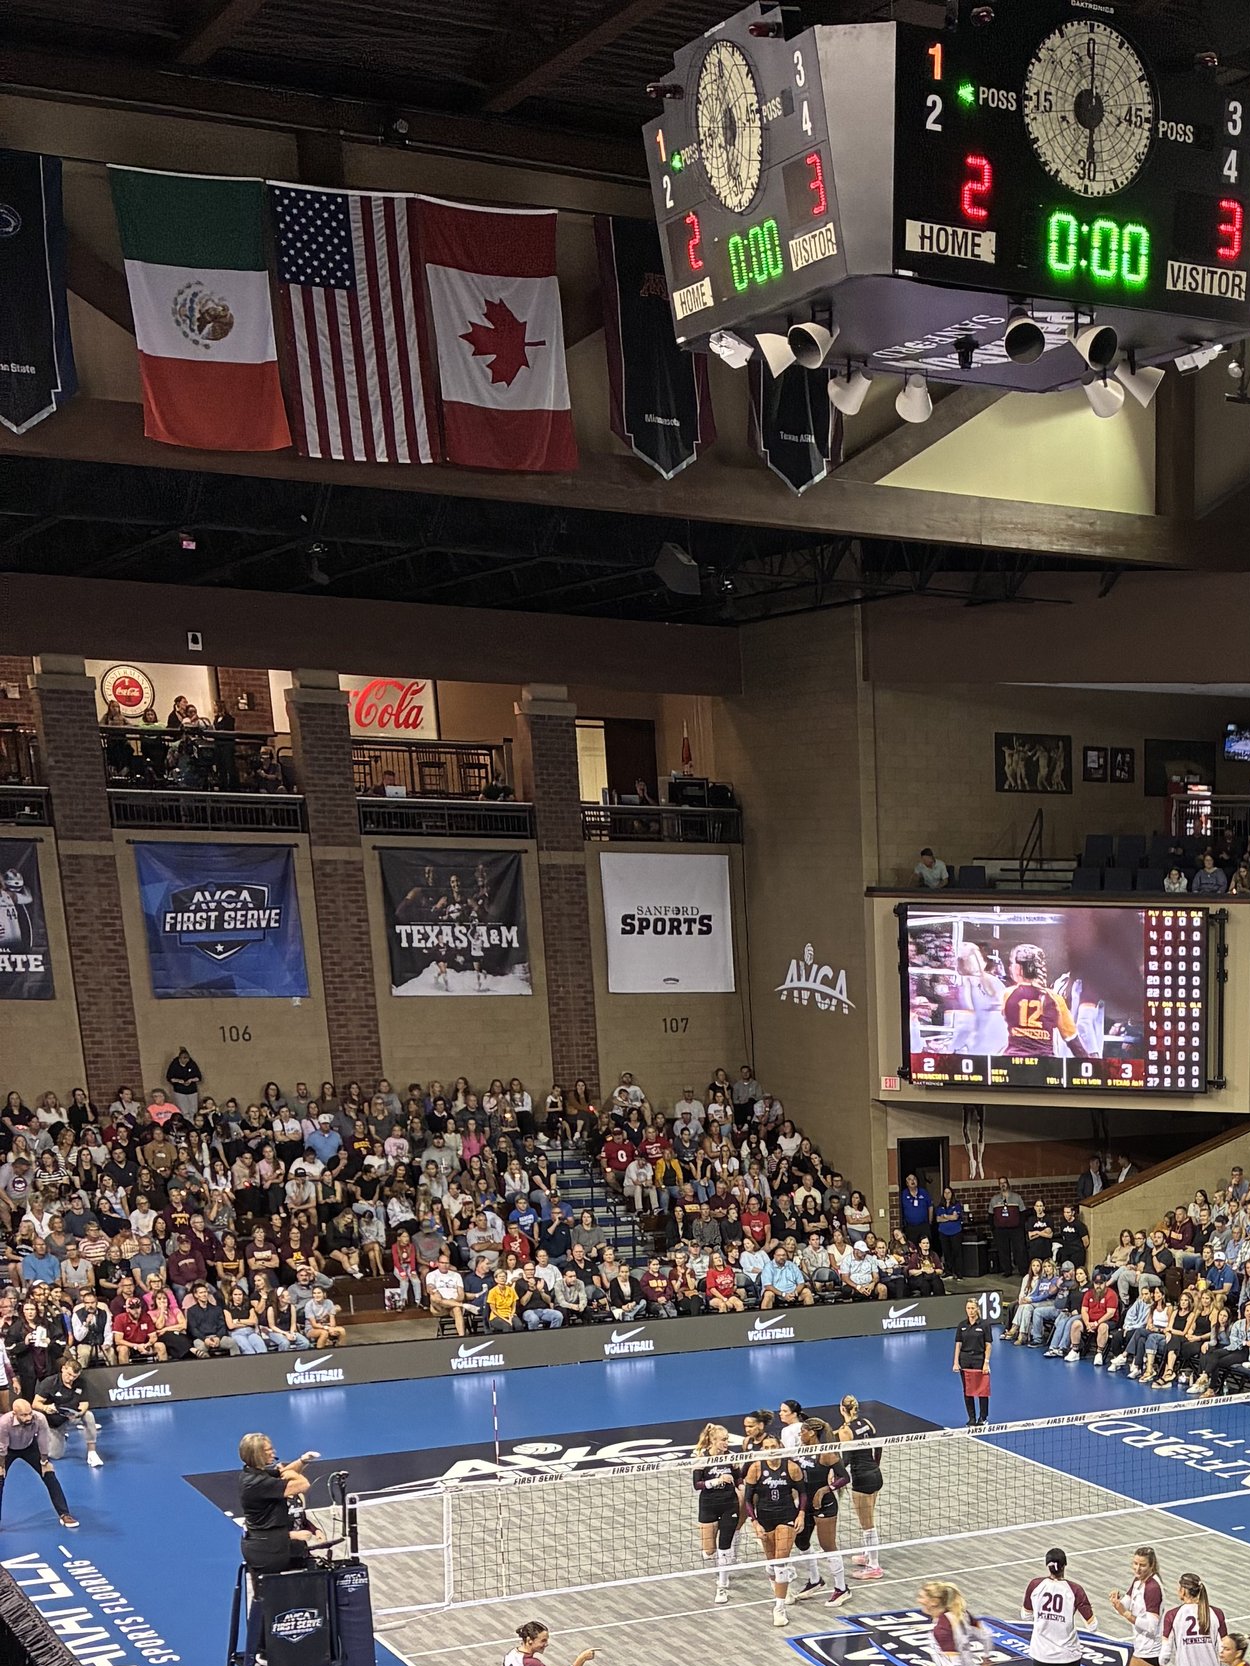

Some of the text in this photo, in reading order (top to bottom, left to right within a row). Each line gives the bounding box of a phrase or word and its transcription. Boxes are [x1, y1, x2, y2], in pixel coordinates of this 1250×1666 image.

[793, 50, 804, 87] 3
[928, 43, 942, 80] 1
[979, 86, 1017, 112] POSS
[1032, 90, 1053, 113] 15
[762, 97, 783, 125] POSS
[801, 100, 813, 136] 4
[925, 94, 942, 132] 2
[1124, 106, 1143, 129] 45
[1227, 100, 1243, 136] 3
[1158, 120, 1194, 144] POSS
[656, 129, 666, 162] 1
[1077, 159, 1097, 183] 30
[1222, 149, 1238, 184] 4
[662, 174, 674, 209] 2
[806, 153, 827, 216] 3
[962, 153, 992, 221] 2
[684, 211, 703, 270] 2
[1217, 198, 1244, 260] 3
[791, 228, 835, 268] VISITOR
[919, 225, 982, 259] HOME
[1049, 210, 1150, 284] 0:00
[728, 219, 783, 292] 0:00
[1169, 263, 1245, 299] VISITOR
[679, 282, 707, 314] HOME
[10, 362, 36, 374] State
[644, 413, 680, 427] Minnesota
[189, 889, 255, 910] AVCA
[635, 905, 700, 917] SANFORD
[164, 909, 281, 932] FIRST SERVE
[620, 914, 713, 937] SPORTS
[1164, 916, 1172, 926] 0
[1178, 916, 1186, 926] 0
[1192, 916, 1201, 927] 0
[395, 924, 520, 949] TEXAS A&M
[774, 957, 856, 1015] AVCA
[1018, 998, 1043, 1028] 12
[218, 1025, 252, 1043] 106
[661, 1018, 690, 1034] 107
[923, 1059, 935, 1072] 2
[961, 1059, 974, 1073] 0
[1177, 1051, 1185, 1061] 0
[1191, 1051, 1200, 1062] 0
[1081, 1062, 1094, 1078] 0
[1121, 1063, 1133, 1078] 3
[884, 1077, 897, 1089] EXIT
[1177, 1077, 1185, 1088] 0
[1191, 1078, 1199, 1088] 0
[977, 1292, 1002, 1320] 13
[881, 1314, 927, 1330] VOLLEYBALL
[746, 1327, 796, 1342] VOLLEYBALL
[603, 1339, 655, 1355] VOLLEYBALL
[450, 1354, 505, 1371] VOLLEYBALL
[286, 1368, 345, 1385] VOLLEYBALL
[108, 1384, 172, 1401] VOLLEYBALL
[797, 1442, 843, 1455] FIRST SERVE
[883, 1434, 927, 1445] FIRST SERVE
[612, 1462, 662, 1475] FIRST SERVE
[706, 1452, 754, 1465] FIRST SERVE
[513, 1473, 566, 1486] FIRST SERVE
[762, 1477, 788, 1489] Aggies
[771, 1490, 780, 1501] 9
[62, 1558, 135, 1616] FLOORING
[1042, 1592, 1063, 1612] 20
[272, 1618, 322, 1632] FIRST SERVE
[283, 1611, 311, 1623] AVCA
[114, 1615, 182, 1665] SPORTS
